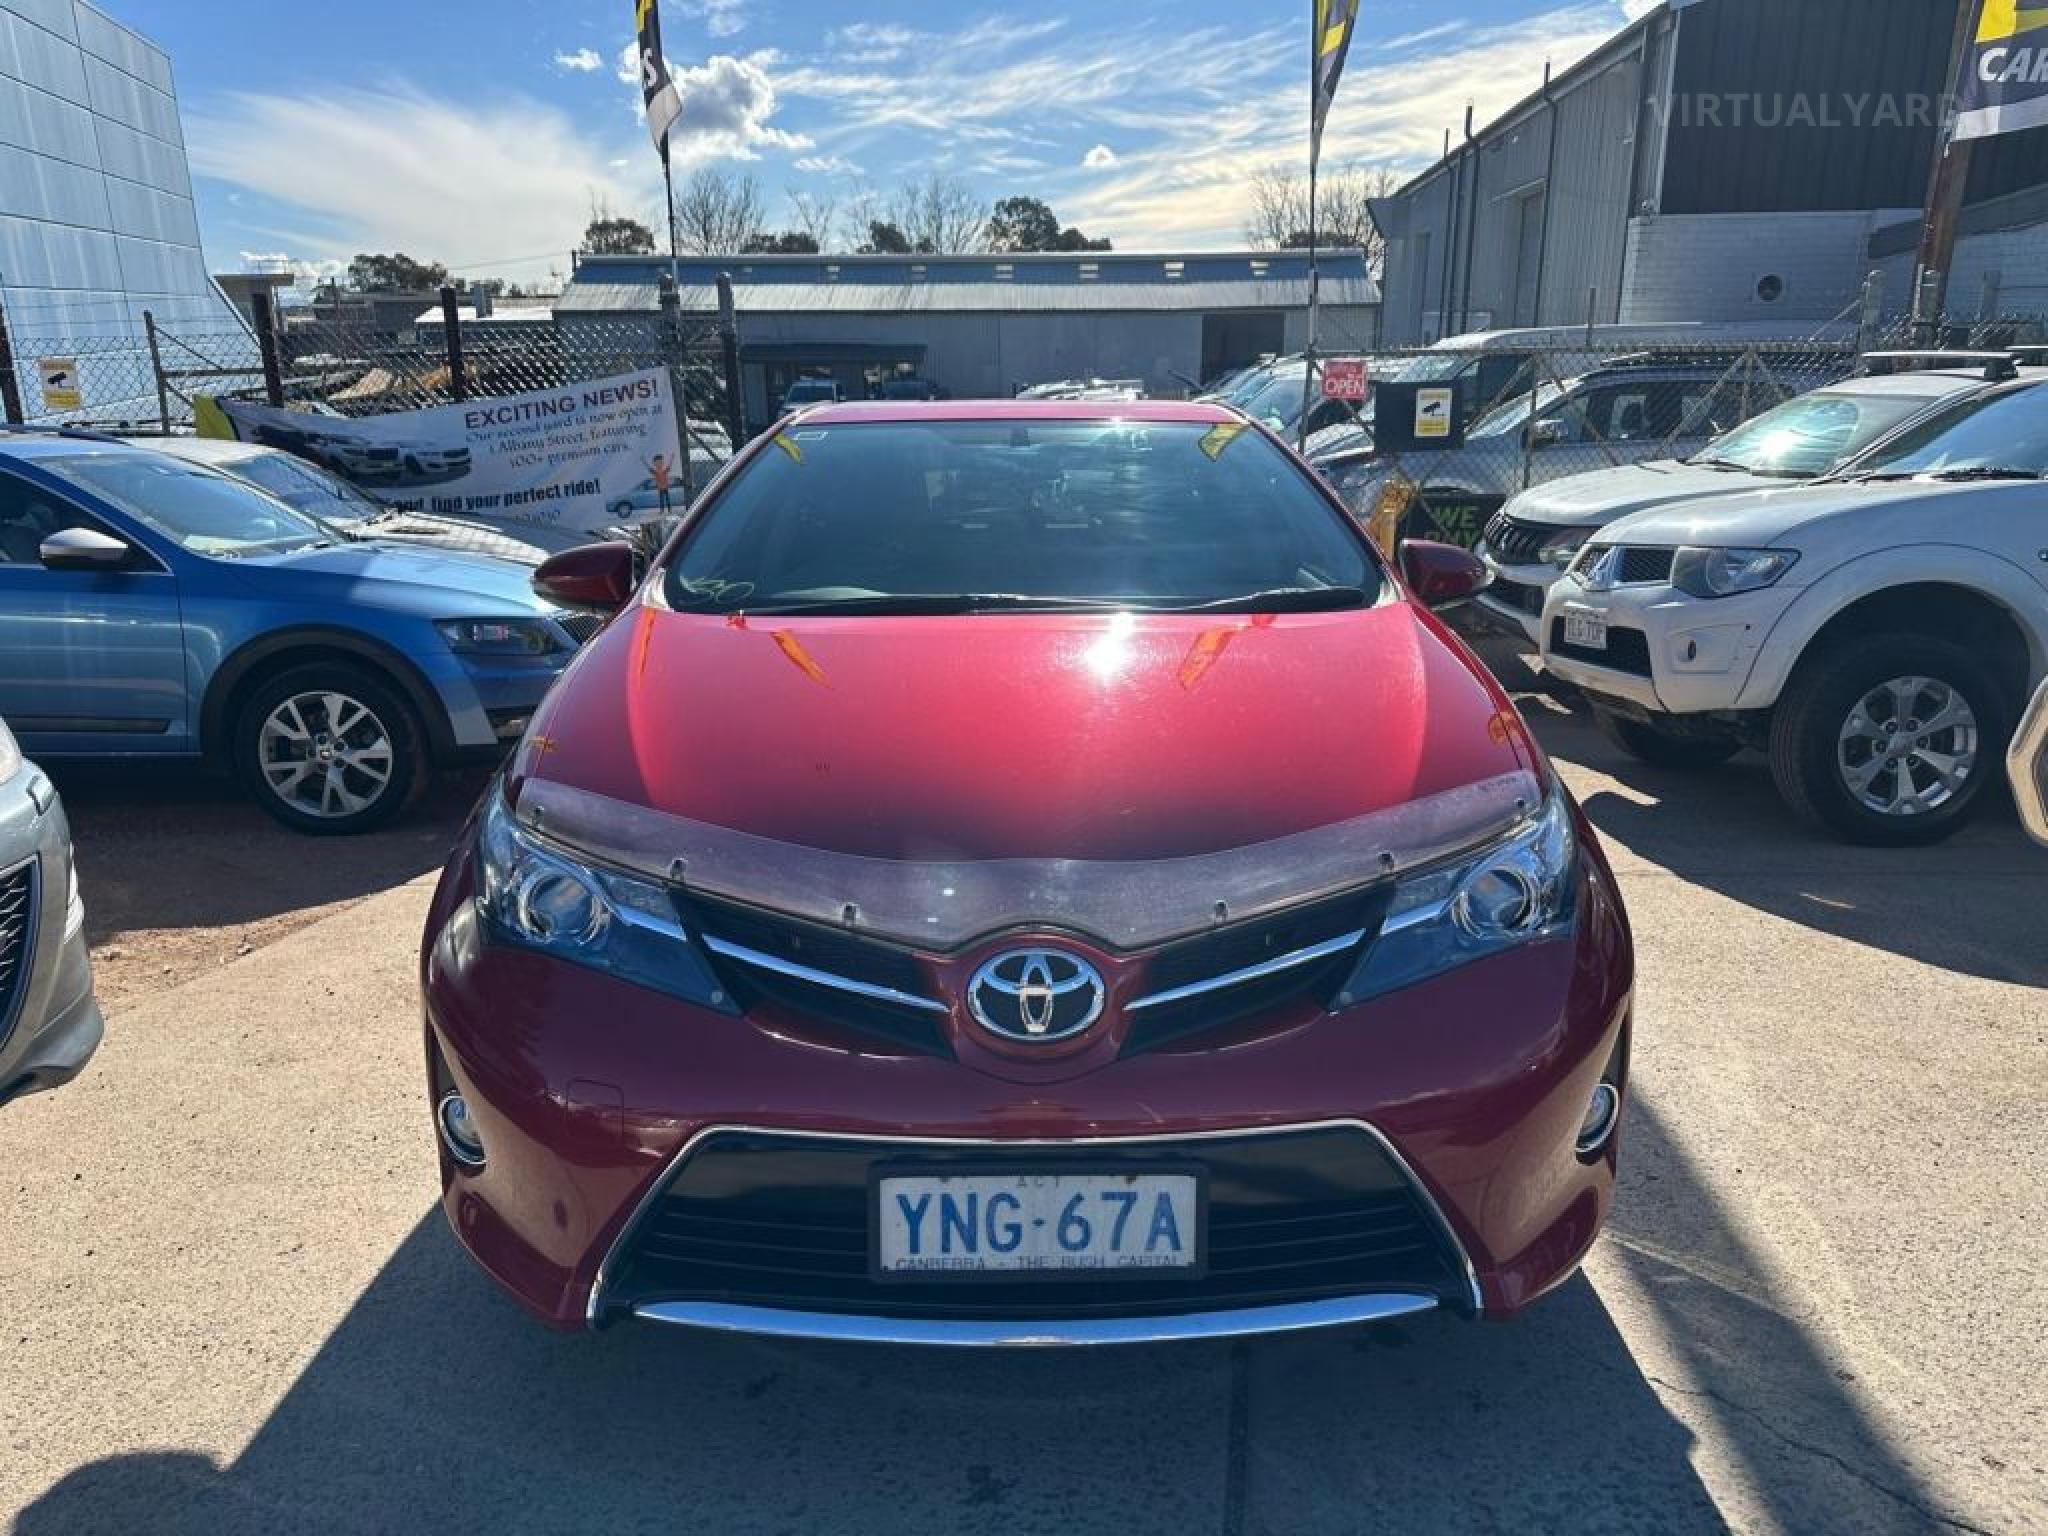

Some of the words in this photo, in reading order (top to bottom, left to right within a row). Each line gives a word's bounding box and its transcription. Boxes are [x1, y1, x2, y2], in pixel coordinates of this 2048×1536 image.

[1325, 377, 1365, 395] OPEN
[464, 395, 576, 429] EXCITING
[583, 378, 658, 408] NEWS!
[465, 494, 500, 511] your
[503, 484, 561, 508] perfect
